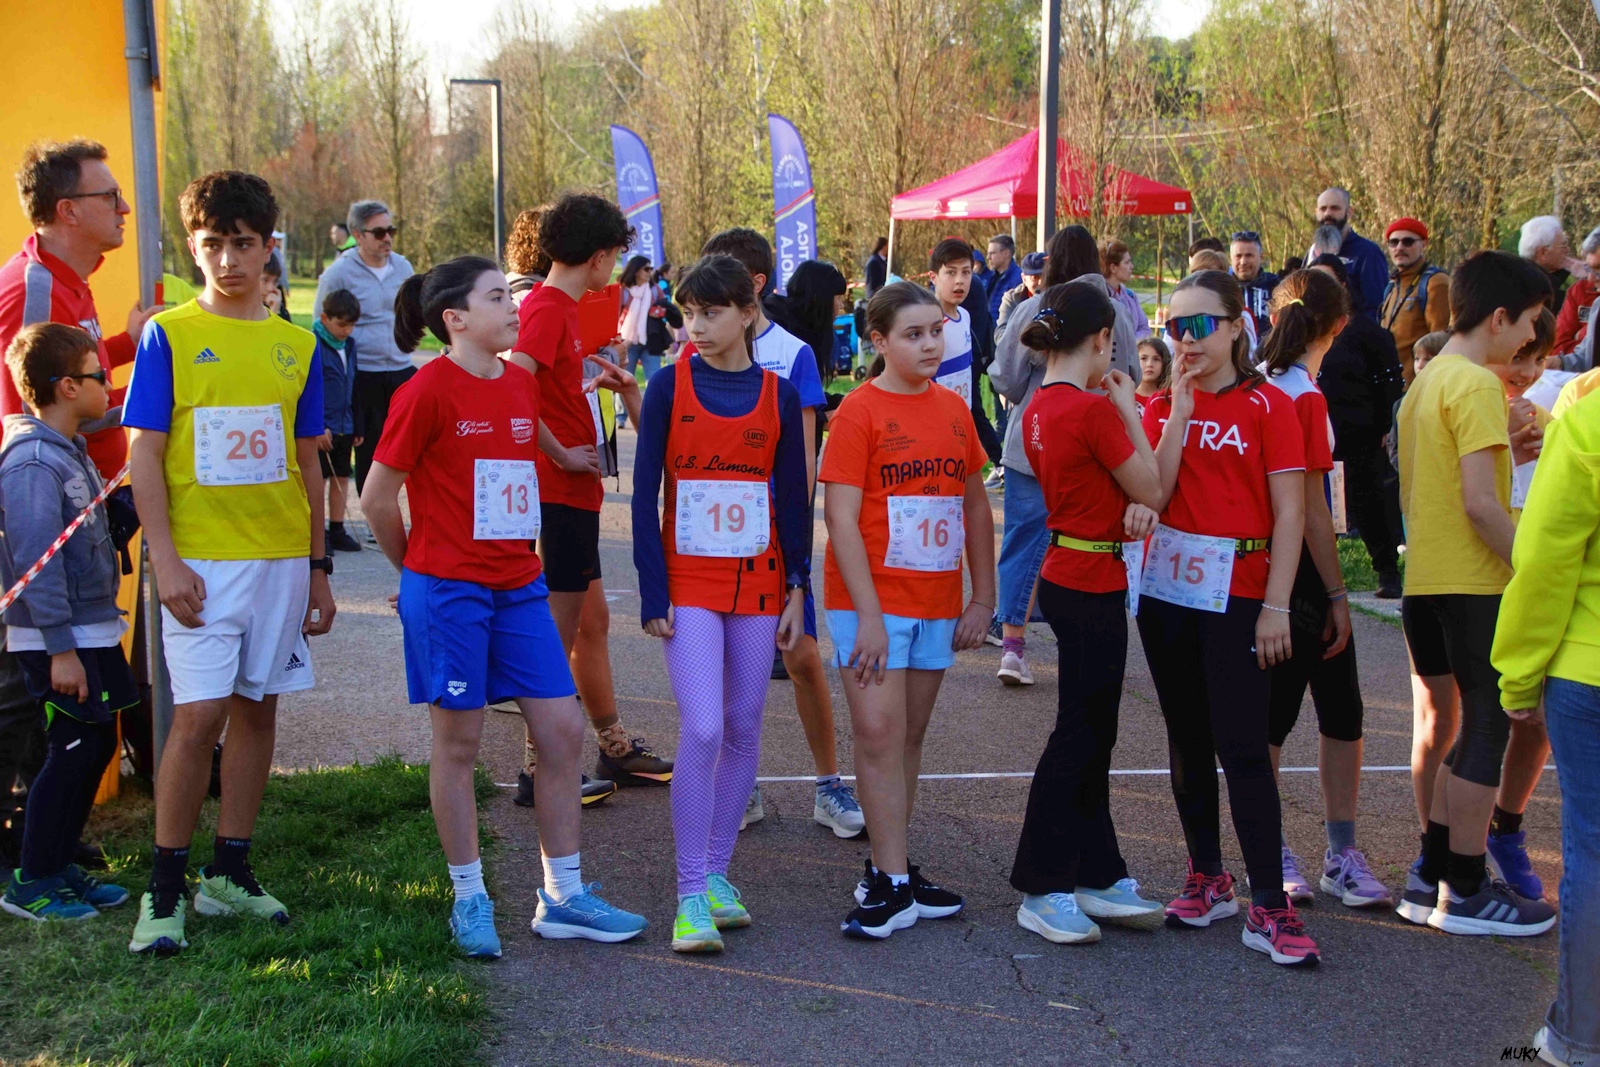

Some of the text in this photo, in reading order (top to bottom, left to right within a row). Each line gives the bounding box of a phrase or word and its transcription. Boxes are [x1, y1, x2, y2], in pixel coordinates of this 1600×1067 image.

[193, 356, 221, 365] adidas
[226, 429, 268, 460] 26
[703, 455, 766, 477] Lamone
[501, 483, 529, 514] 13
[922, 484, 940, 495] del
[706, 502, 745, 533] 19
[917, 518, 949, 548] 16
[1169, 552, 1205, 585] 15
[284, 661, 305, 672] adidas
[447, 680, 467, 688] arena
